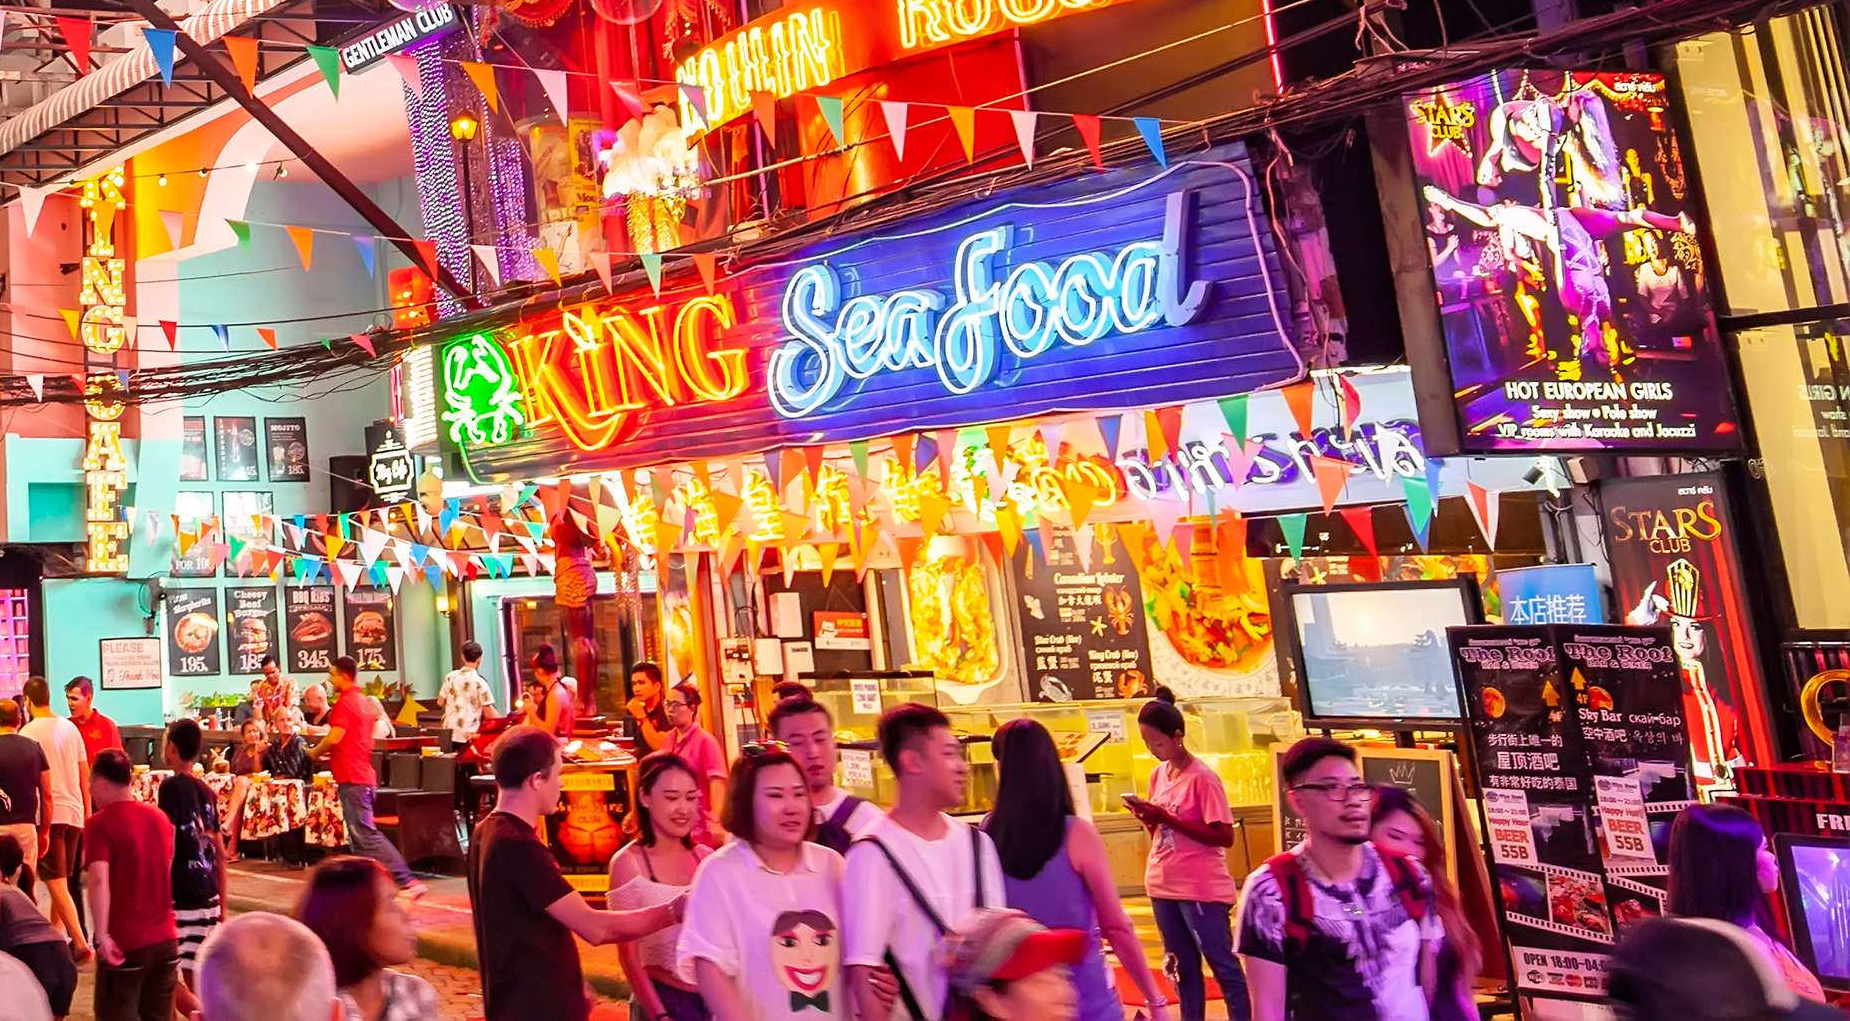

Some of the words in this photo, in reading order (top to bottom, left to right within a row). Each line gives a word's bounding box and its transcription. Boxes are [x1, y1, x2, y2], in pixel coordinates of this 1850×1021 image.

[341, 17, 418, 68] GENTLEMAN
[415, 2, 454, 34] CLUB
[1410, 99, 1475, 129] STARS
[1505, 382, 1539, 400] HOT
[1543, 382, 1627, 400] EUROPEAN
[1630, 382, 1674, 400] GIRLS
[1611, 500, 1722, 541] STARS
[1650, 538, 1691, 554] CLUB
[292, 590, 309, 604] BBQ
[1510, 595, 1587, 625] 本店推荐
[1460, 647, 1504, 663] The
[1563, 643, 1612, 663] The
[1616, 645, 1674, 663] Roof
[1578, 708, 1599, 723] Sky
[1601, 709, 1623, 722] Bar
[1497, 751, 1561, 771] 屋顶酒吧
[1607, 819, 1645, 835] BEER
[1494, 829, 1530, 844] BEER
[1614, 835, 1644, 852] 55B
[1501, 844, 1530, 860] 55B
[1524, 952, 1548, 967] OPEN
